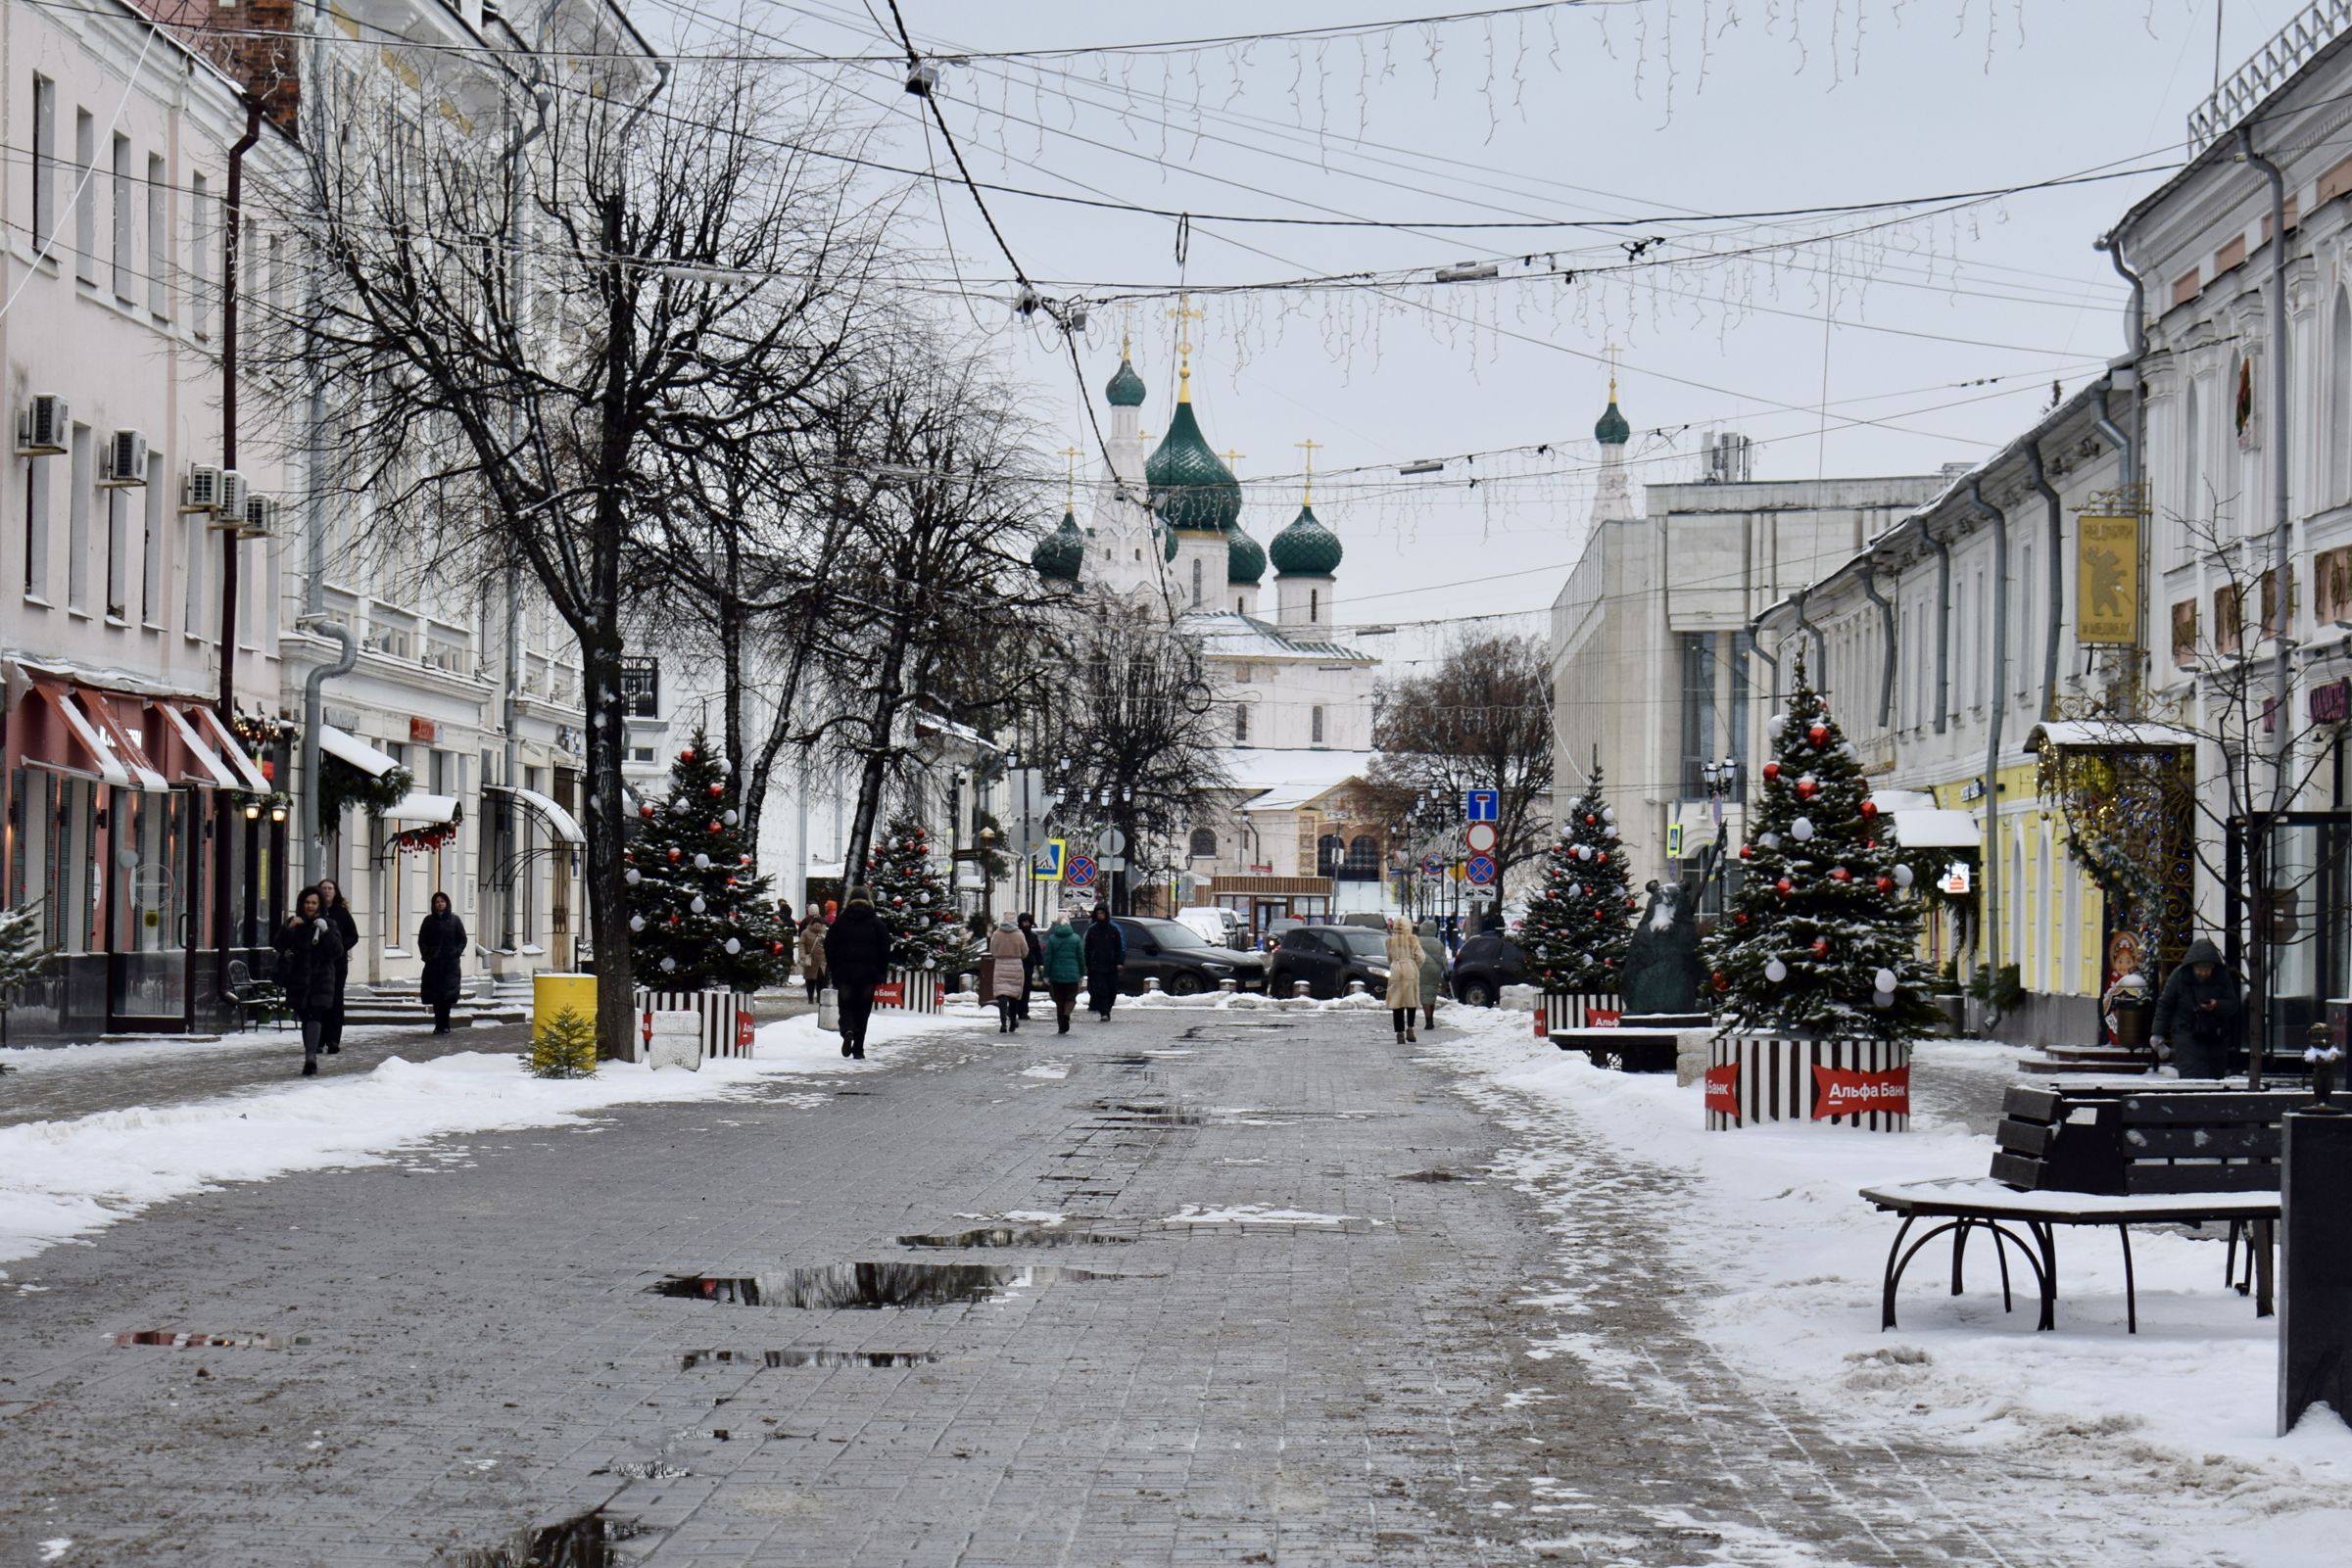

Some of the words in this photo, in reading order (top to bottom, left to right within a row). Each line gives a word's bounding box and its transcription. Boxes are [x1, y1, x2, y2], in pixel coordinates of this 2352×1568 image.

[1595, 1018, 1620, 1028] Альф
[1708, 1079, 1728, 1095] Банк
[1828, 1082, 1879, 1103] Альфа
[1881, 1081, 1905, 1097] Банк
